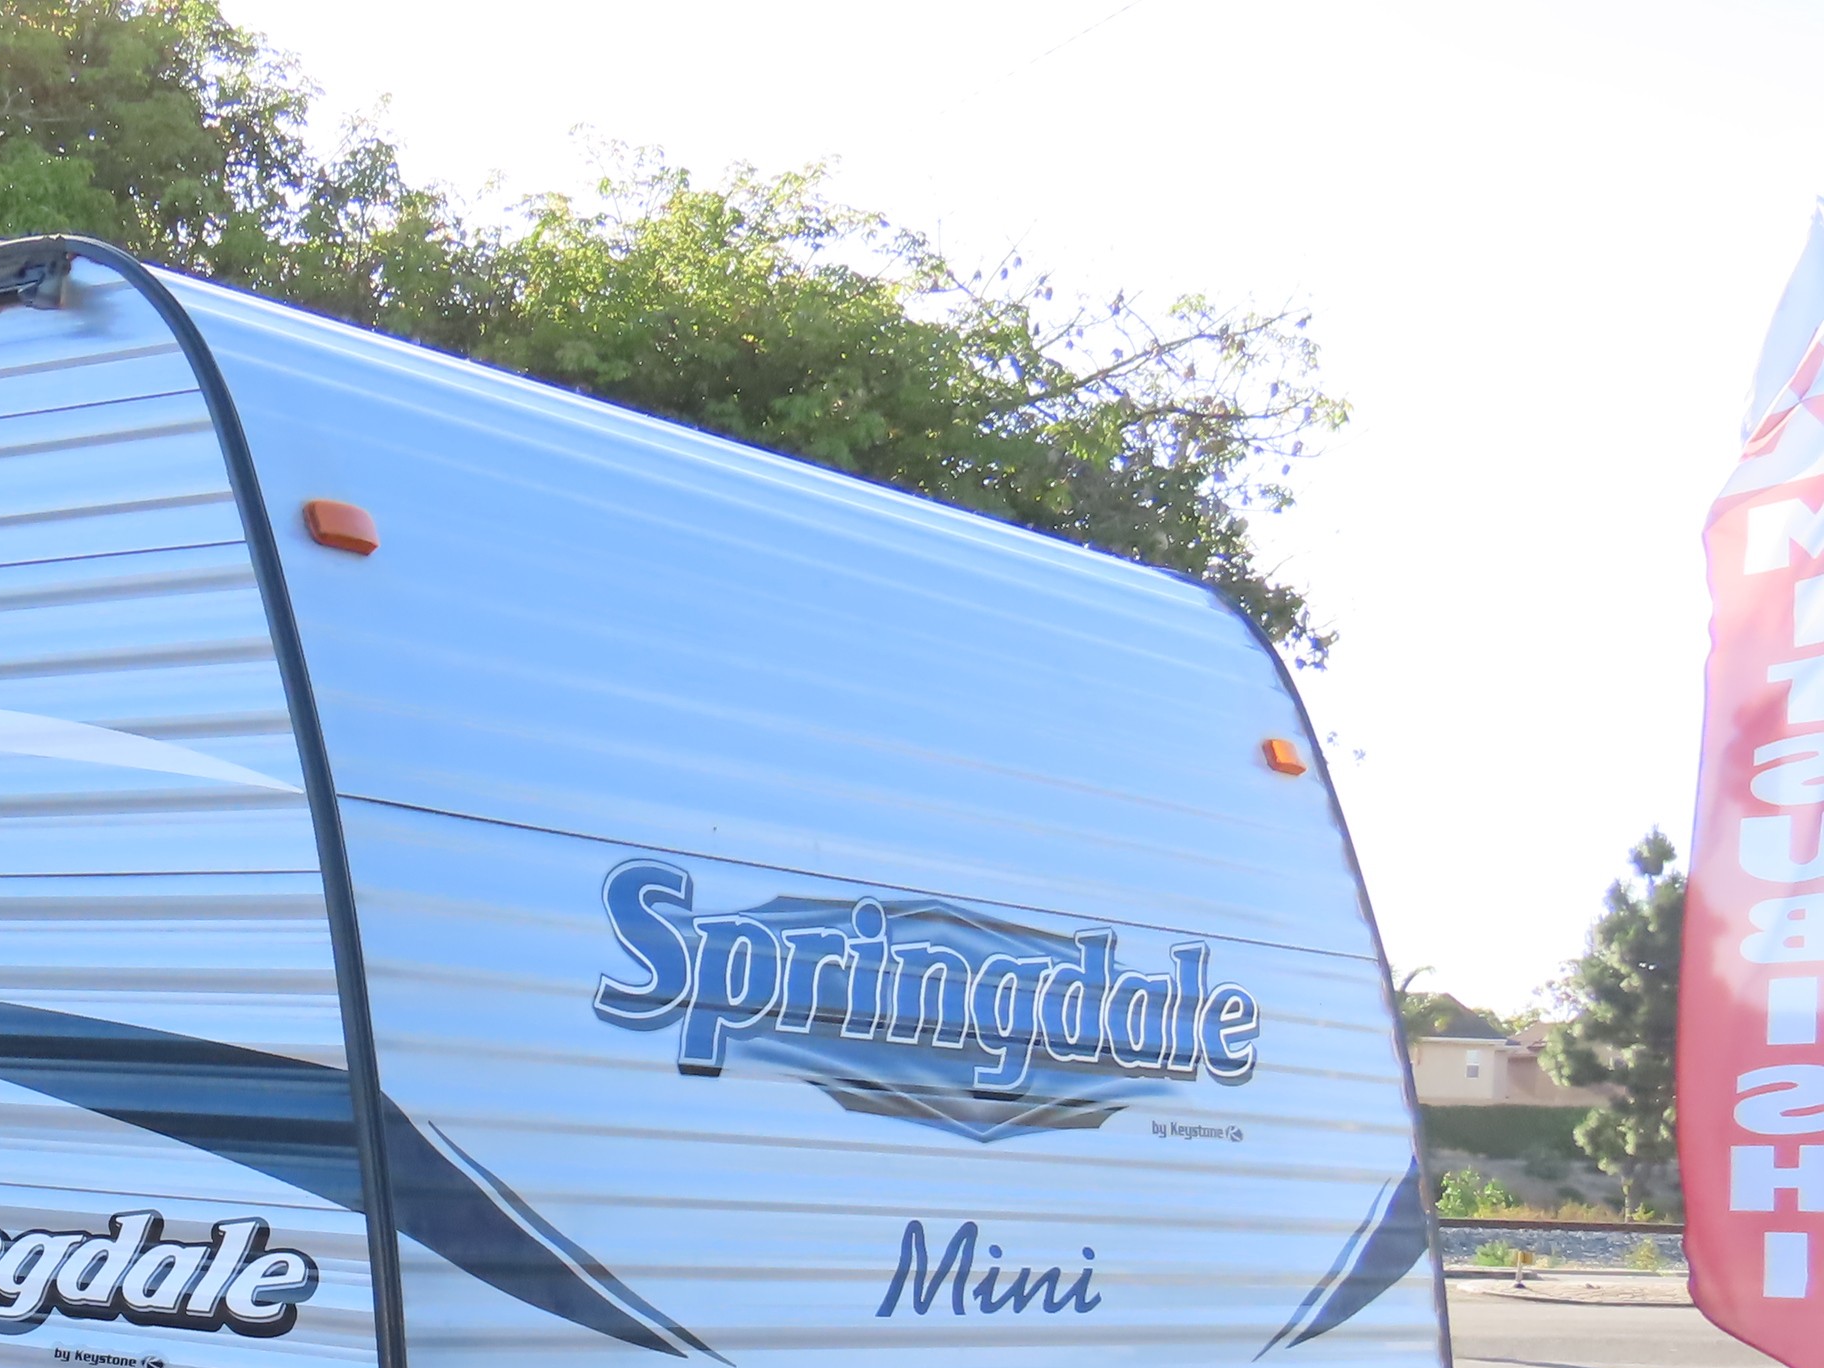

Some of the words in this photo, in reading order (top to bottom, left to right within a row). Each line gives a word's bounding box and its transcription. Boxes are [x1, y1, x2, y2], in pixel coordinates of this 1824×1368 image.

[592, 858, 1260, 1099] Springdale
[1152, 1119, 1167, 1138] by
[1170, 1121, 1224, 1140] Keystone
[876, 1220, 1101, 1317] Mini
[54, 1347, 70, 1362] by
[75, 1349, 137, 1367] Keystone
